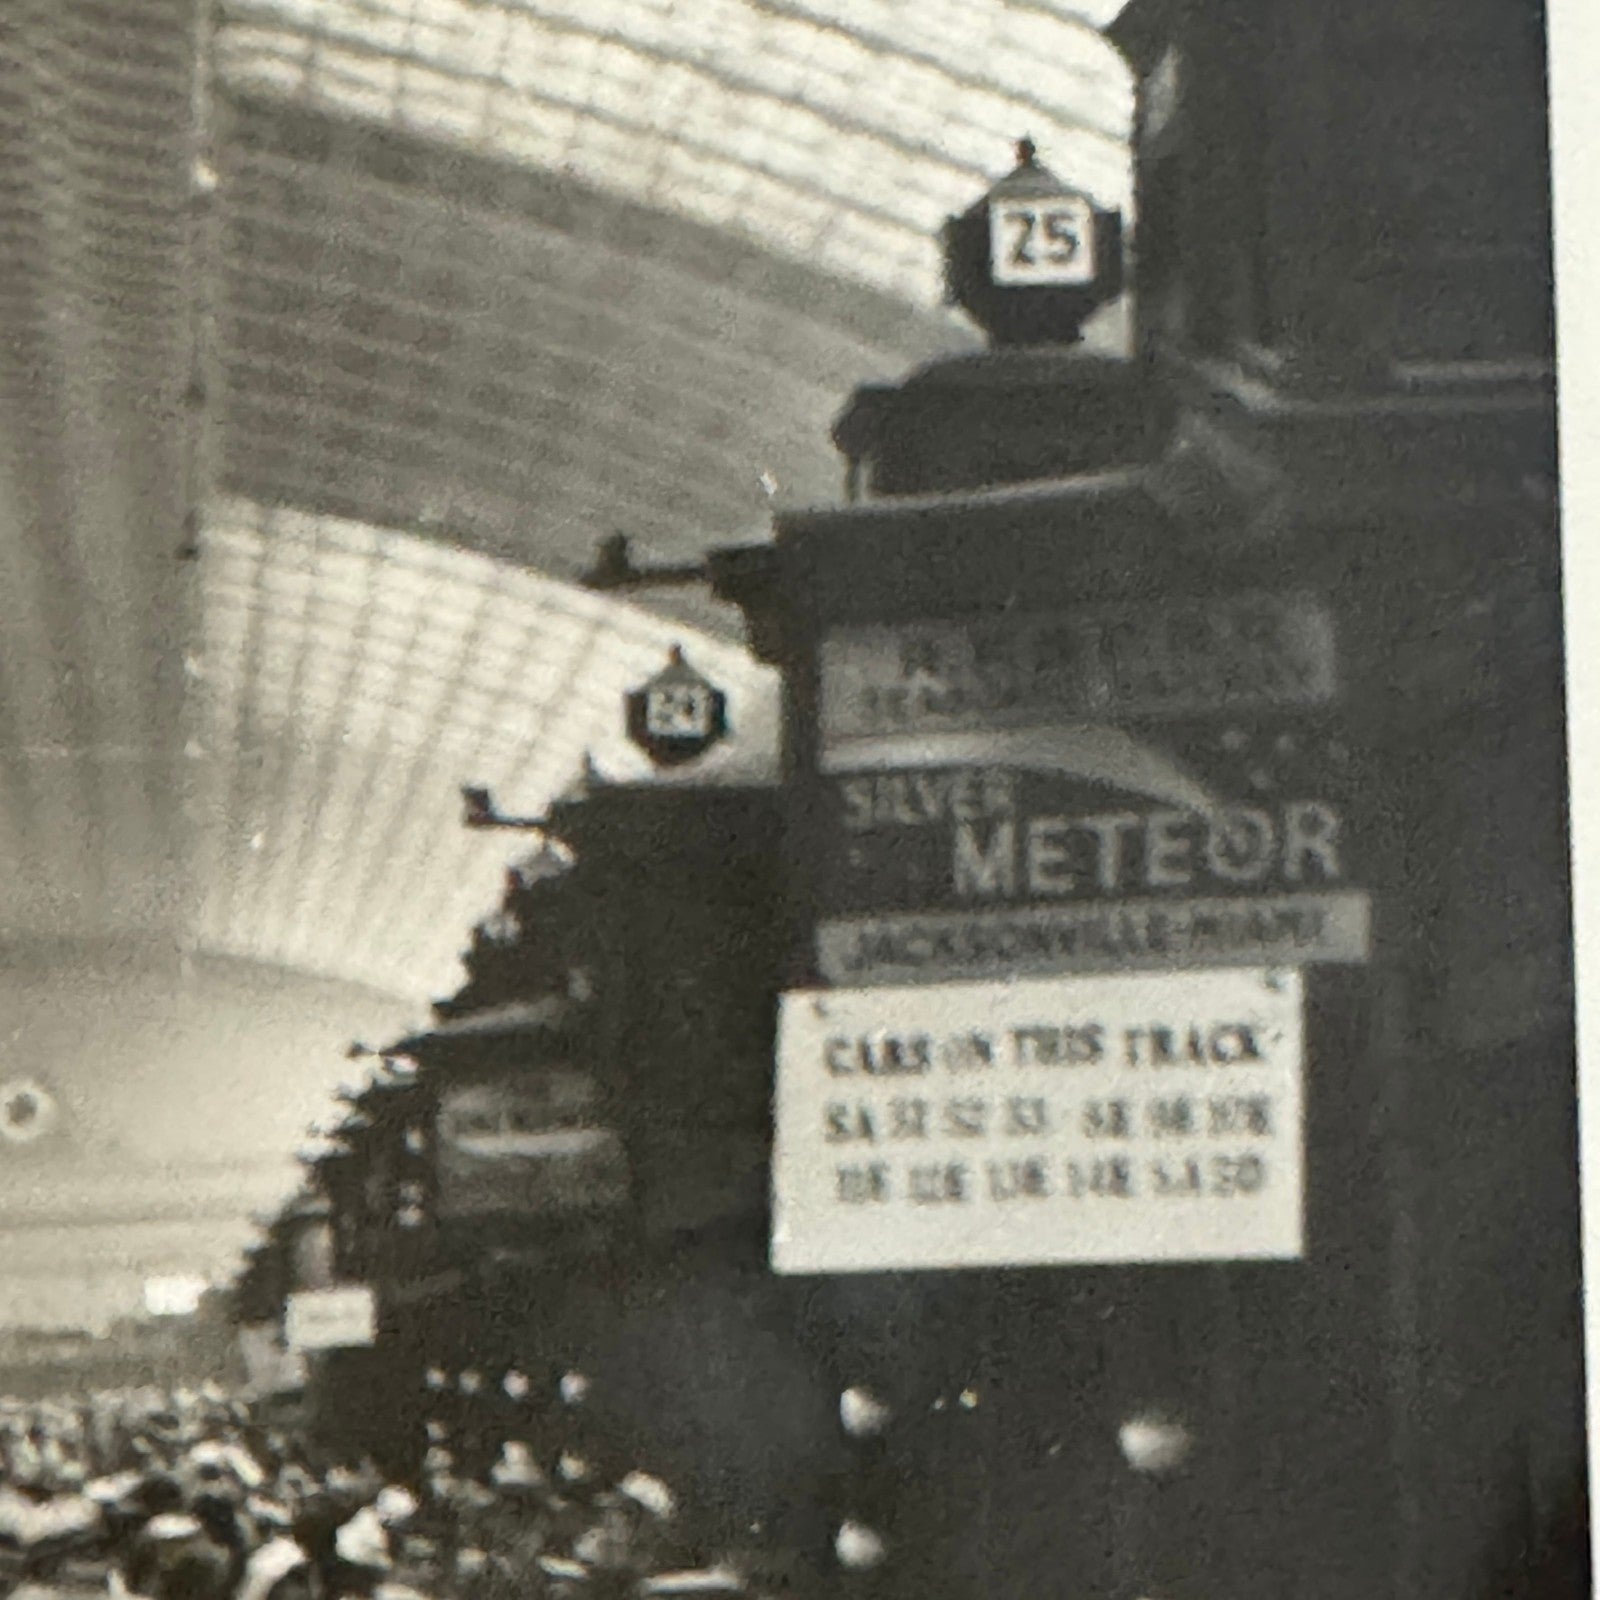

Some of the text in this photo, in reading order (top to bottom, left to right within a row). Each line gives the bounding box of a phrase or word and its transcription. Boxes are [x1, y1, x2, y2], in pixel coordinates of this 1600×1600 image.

[952, 803, 1342, 896] METEOR
[823, 1034, 932, 1078] CARS
[1010, 1022, 1105, 1067] THIS
[1123, 1022, 1264, 1068] TRACK
